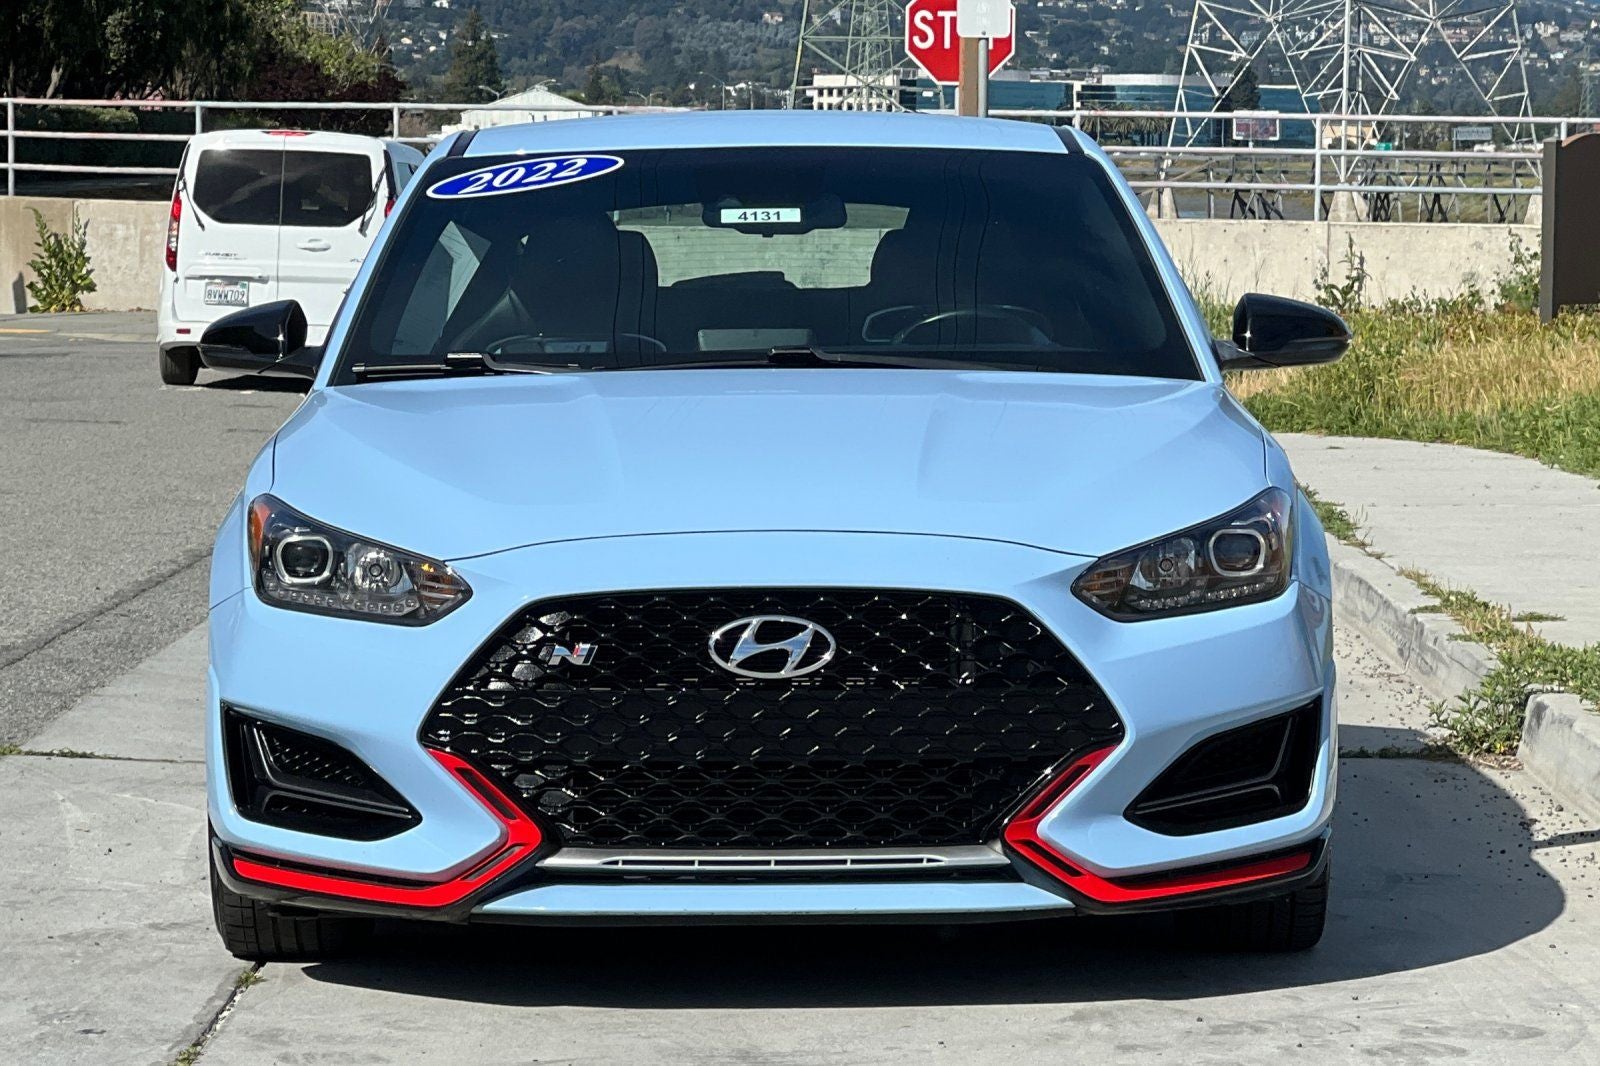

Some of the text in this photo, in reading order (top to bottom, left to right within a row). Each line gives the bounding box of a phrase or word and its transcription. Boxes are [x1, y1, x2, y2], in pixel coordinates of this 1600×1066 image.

[912, 9, 993, 50] ST
[457, 158, 588, 195] 2022
[737, 210, 781, 221] 4131
[206, 289, 246, 301] 8VWW709
